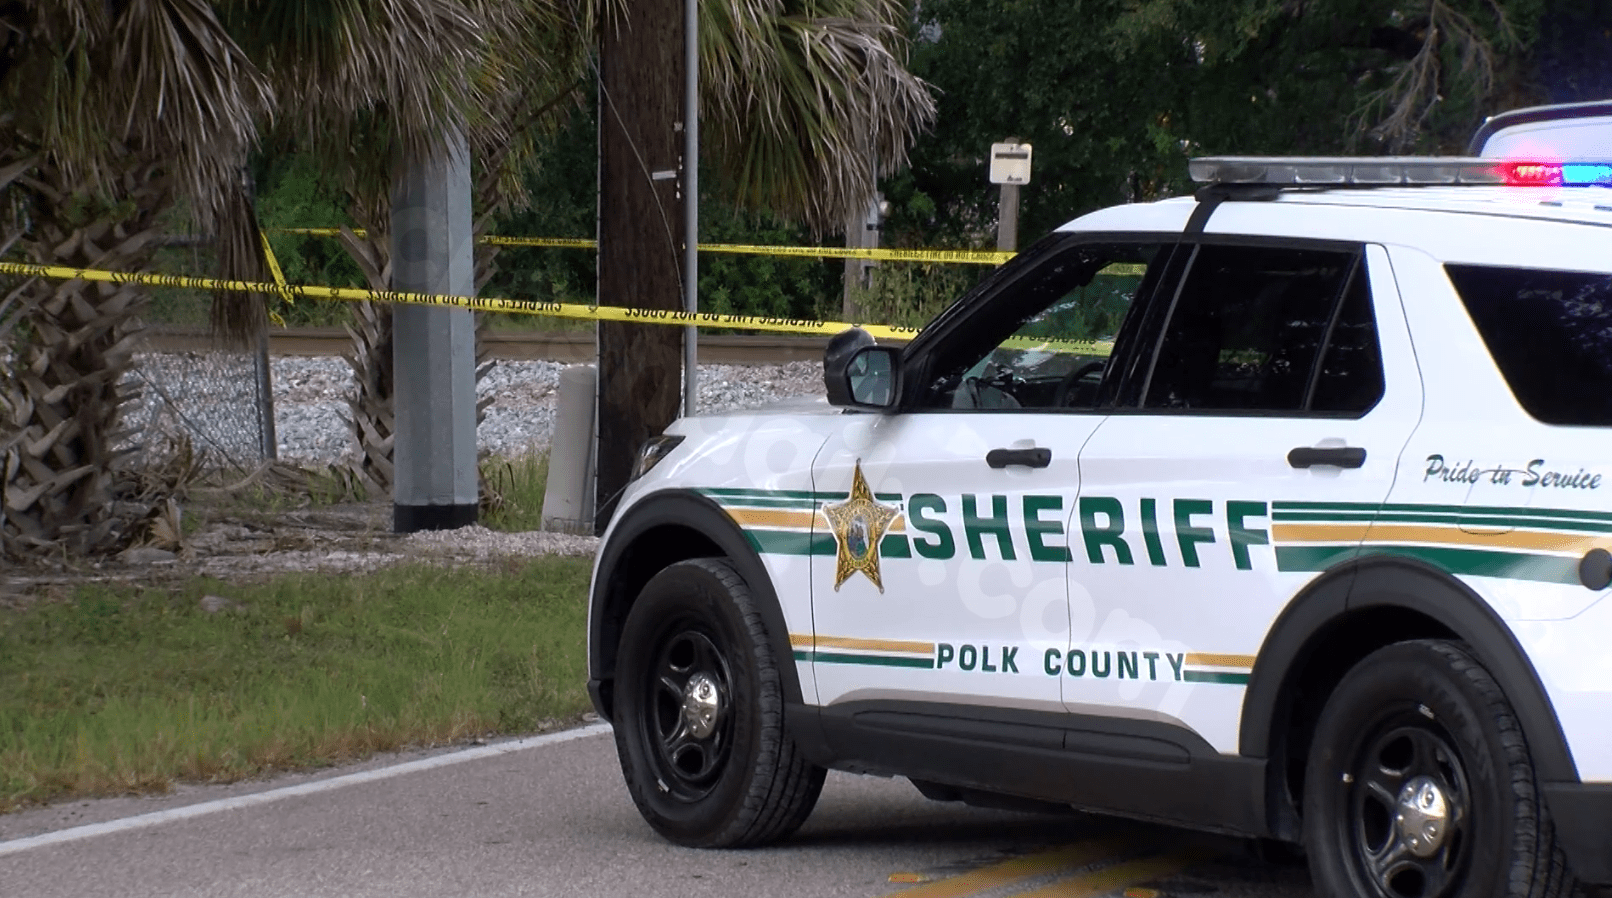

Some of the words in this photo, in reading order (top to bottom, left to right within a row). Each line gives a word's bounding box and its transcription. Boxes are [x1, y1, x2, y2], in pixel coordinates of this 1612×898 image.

[1423, 454, 1481, 484] Pride
[1522, 458, 1602, 490] Service
[908, 492, 1270, 570] SHERIFF
[936, 642, 1020, 674] POLK
[1043, 648, 1185, 682] COUNTY
